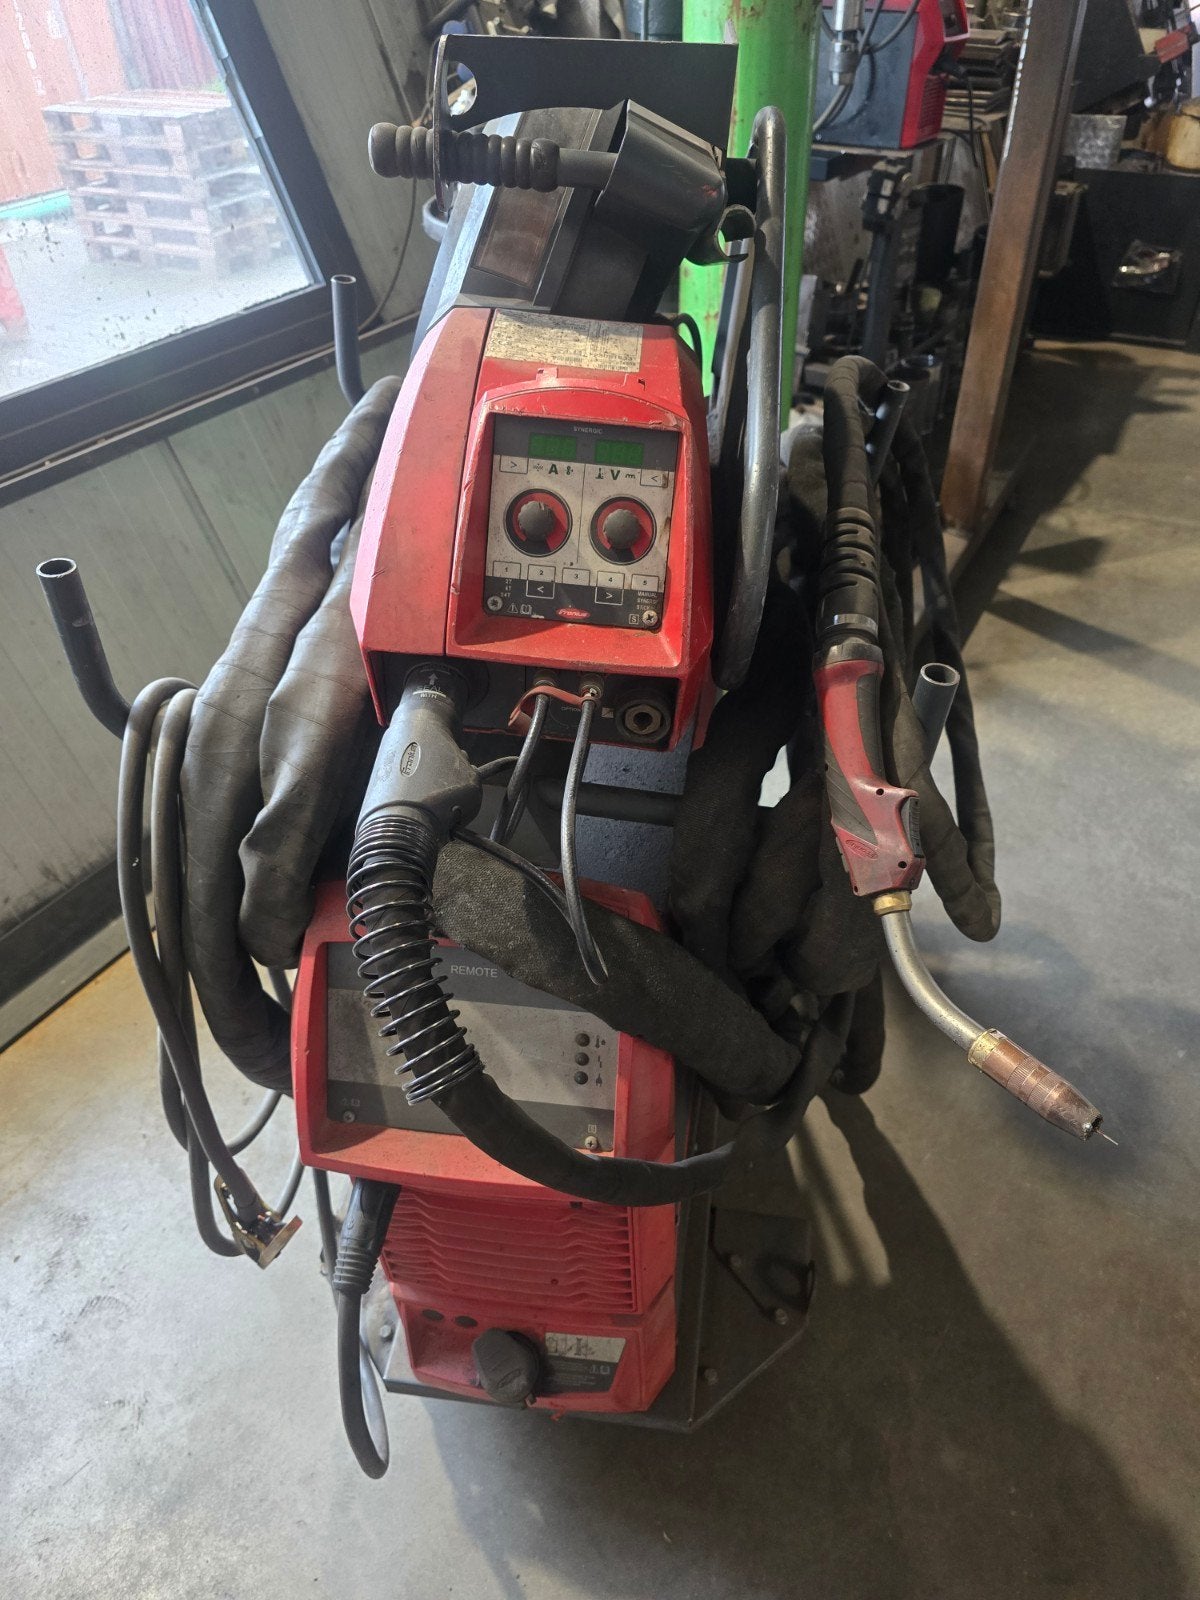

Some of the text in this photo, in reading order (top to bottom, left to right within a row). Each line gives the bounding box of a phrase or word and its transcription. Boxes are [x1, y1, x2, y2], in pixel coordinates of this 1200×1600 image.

[548, 464, 559, 475] A
[610, 470, 621, 481] V
[450, 965, 498, 978] REMOTE
